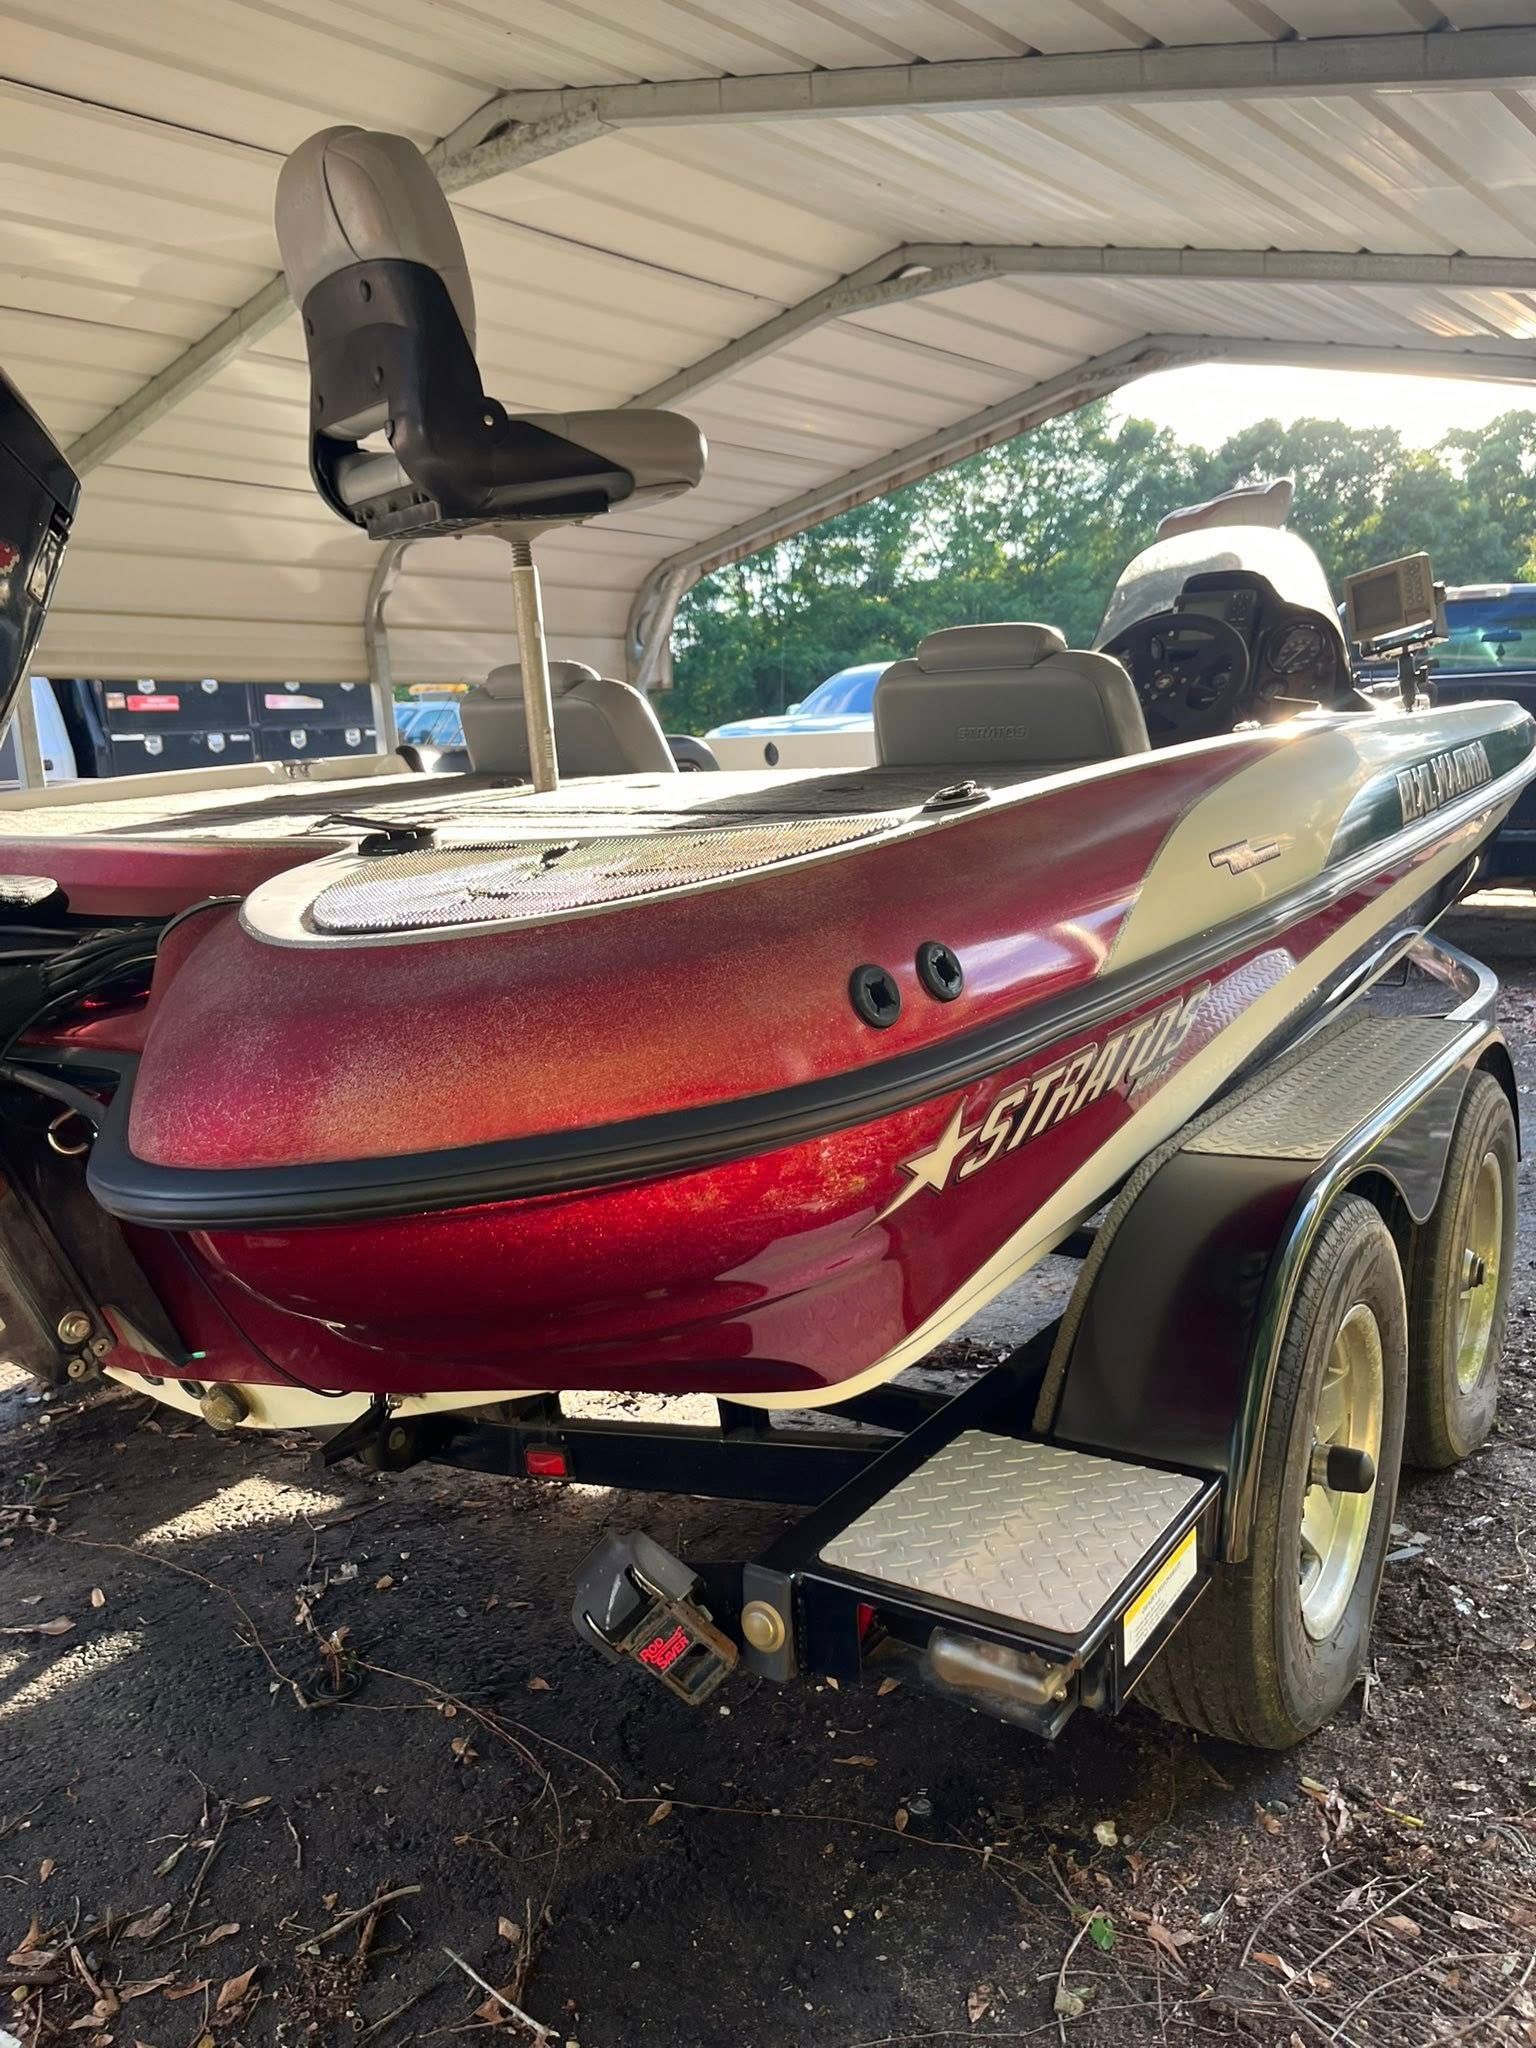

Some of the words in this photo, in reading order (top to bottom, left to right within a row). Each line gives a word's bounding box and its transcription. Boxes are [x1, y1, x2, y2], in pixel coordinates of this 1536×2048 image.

[956, 725, 1027, 742] STRATOS
[957, 979, 1211, 1181] STRATOS
[639, 1637, 664, 1664] ROD
[656, 1635, 690, 1670] SAVER
